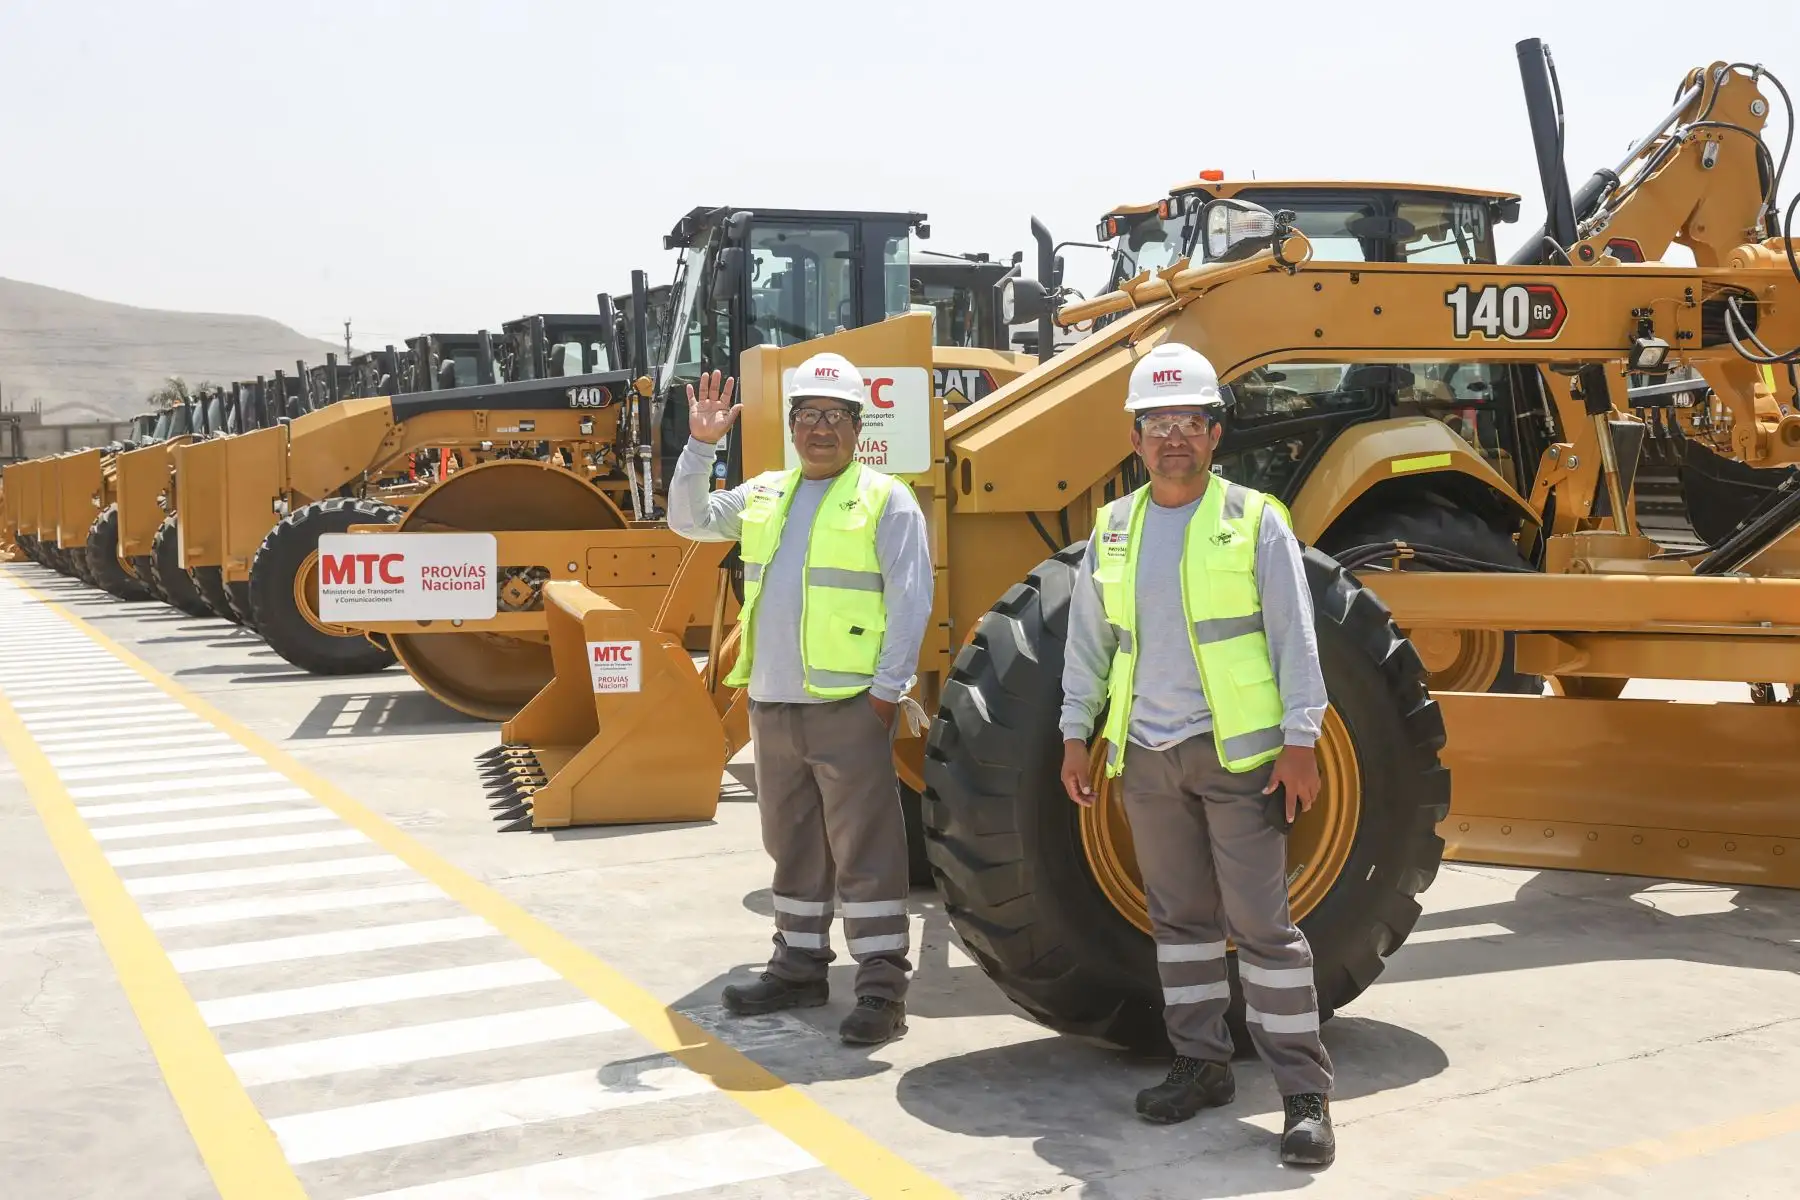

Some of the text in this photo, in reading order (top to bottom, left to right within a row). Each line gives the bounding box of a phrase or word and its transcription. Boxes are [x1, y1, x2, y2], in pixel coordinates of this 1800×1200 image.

[1447, 286, 1551, 337] 140 GC
[815, 367, 840, 378] MTC
[1153, 369, 1182, 383] MTC
[568, 388, 600, 406] 140
[1672, 391, 1690, 406] 140
[857, 437, 888, 453] VÍAS
[854, 453, 888, 465] ional
[321, 553, 405, 585] MTC
[421, 563, 486, 578] PROVÍAS
[422, 578, 485, 591] Nacional
[367, 588, 405, 596] Transportes
[594, 646, 633, 662] MTC
[598, 675, 629, 683] PROVÍAS
[598, 681, 629, 689] Nacional
